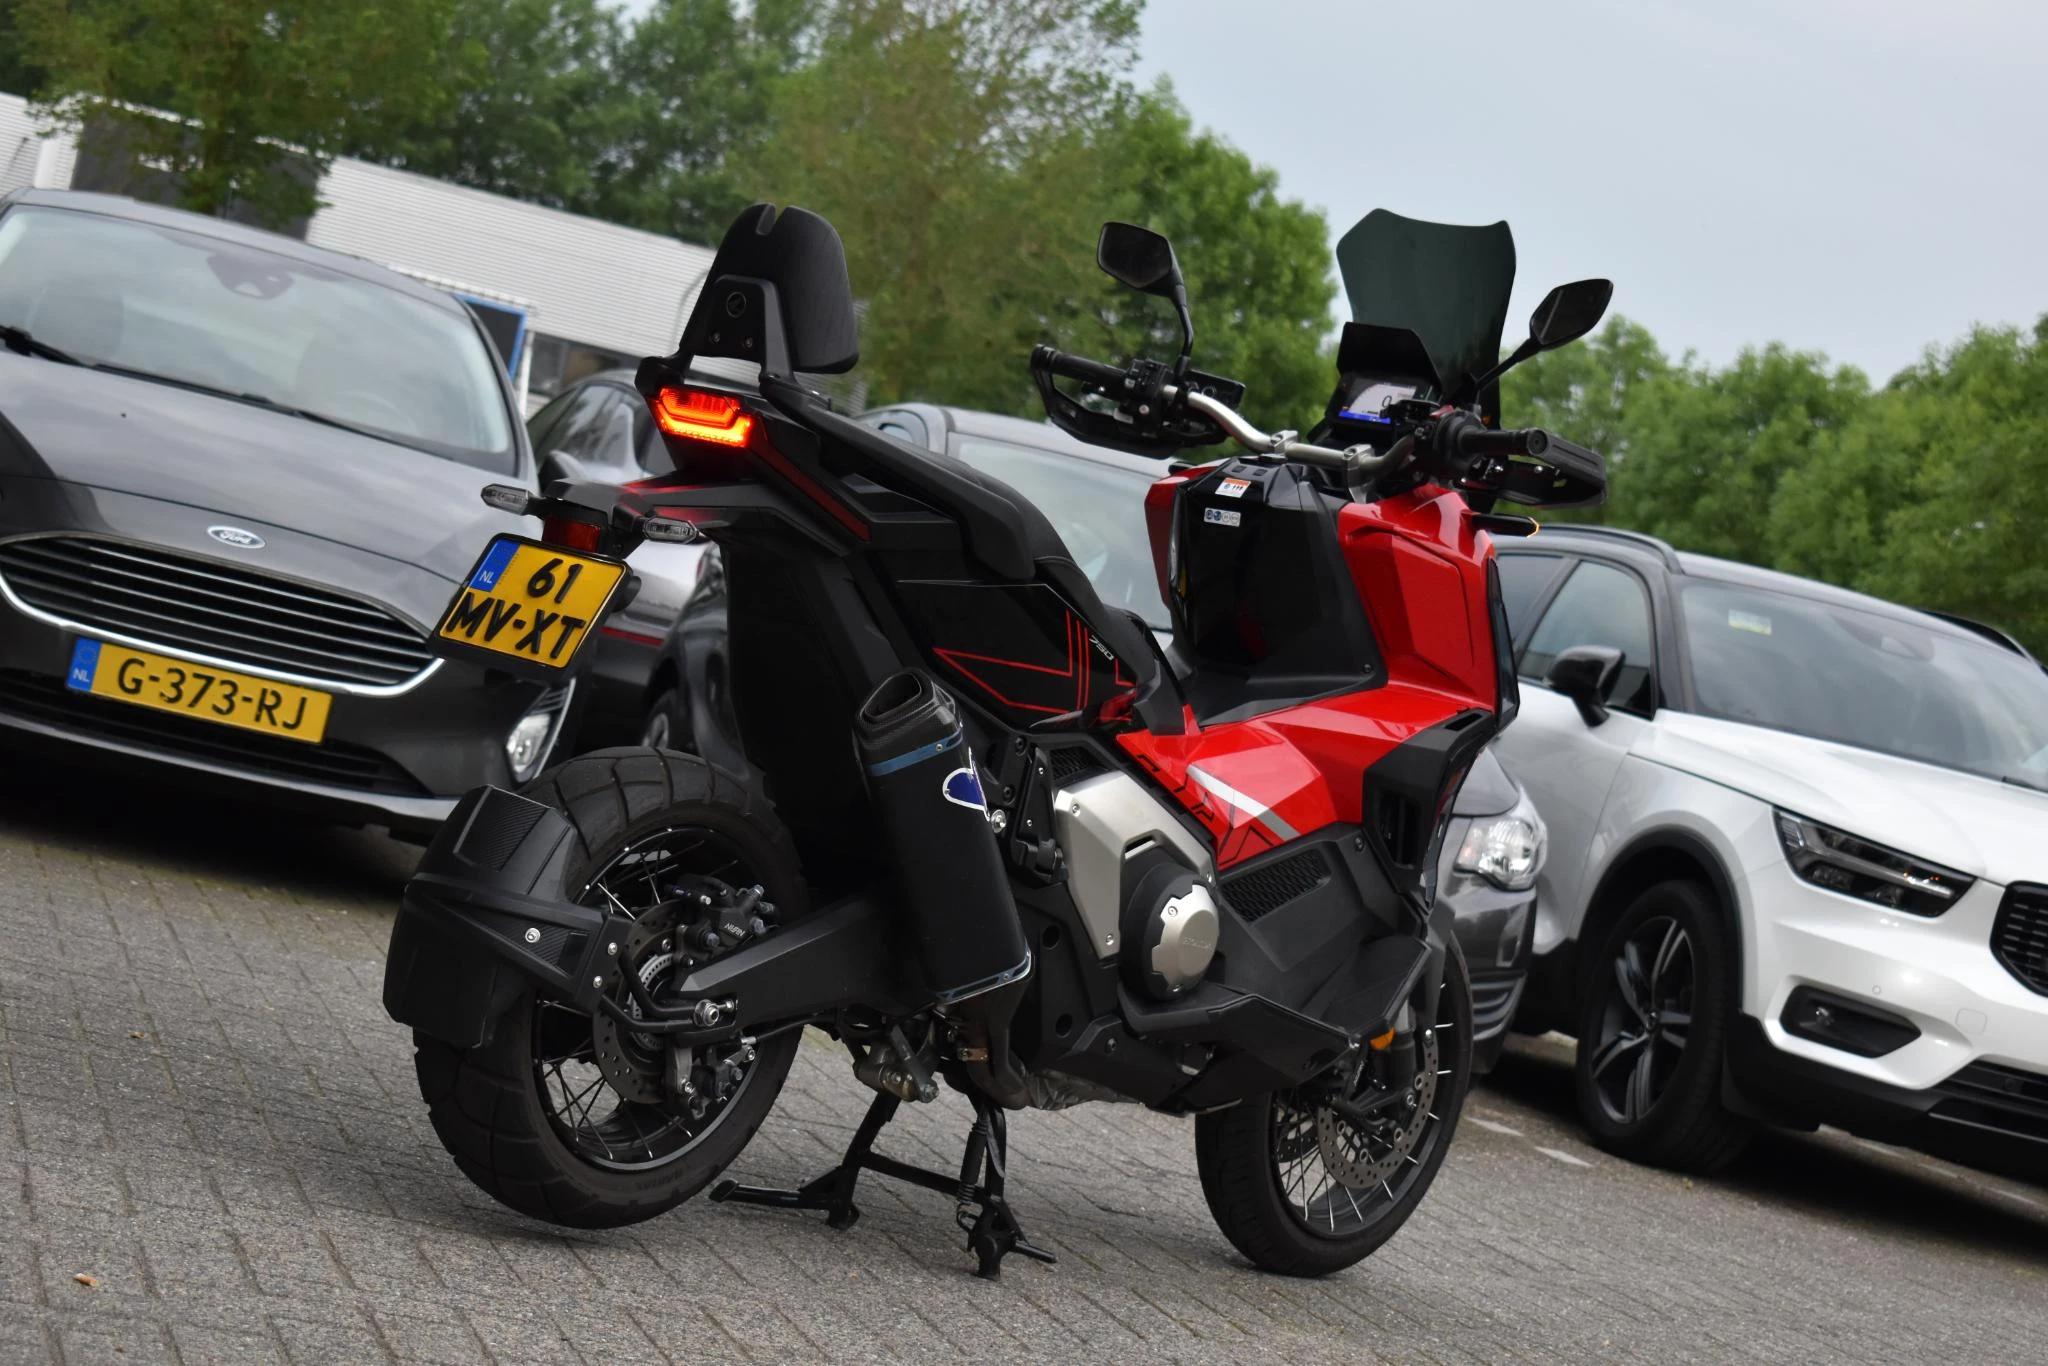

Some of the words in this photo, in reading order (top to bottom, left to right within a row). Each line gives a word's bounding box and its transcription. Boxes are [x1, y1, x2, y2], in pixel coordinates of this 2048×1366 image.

[479, 570, 494, 584] NL
[527, 558, 583, 603] 61
[446, 592, 586, 658] MV-XT
[1089, 635, 1114, 661] 750
[72, 668, 90, 683] NL
[117, 658, 307, 730] G-373-RJ
